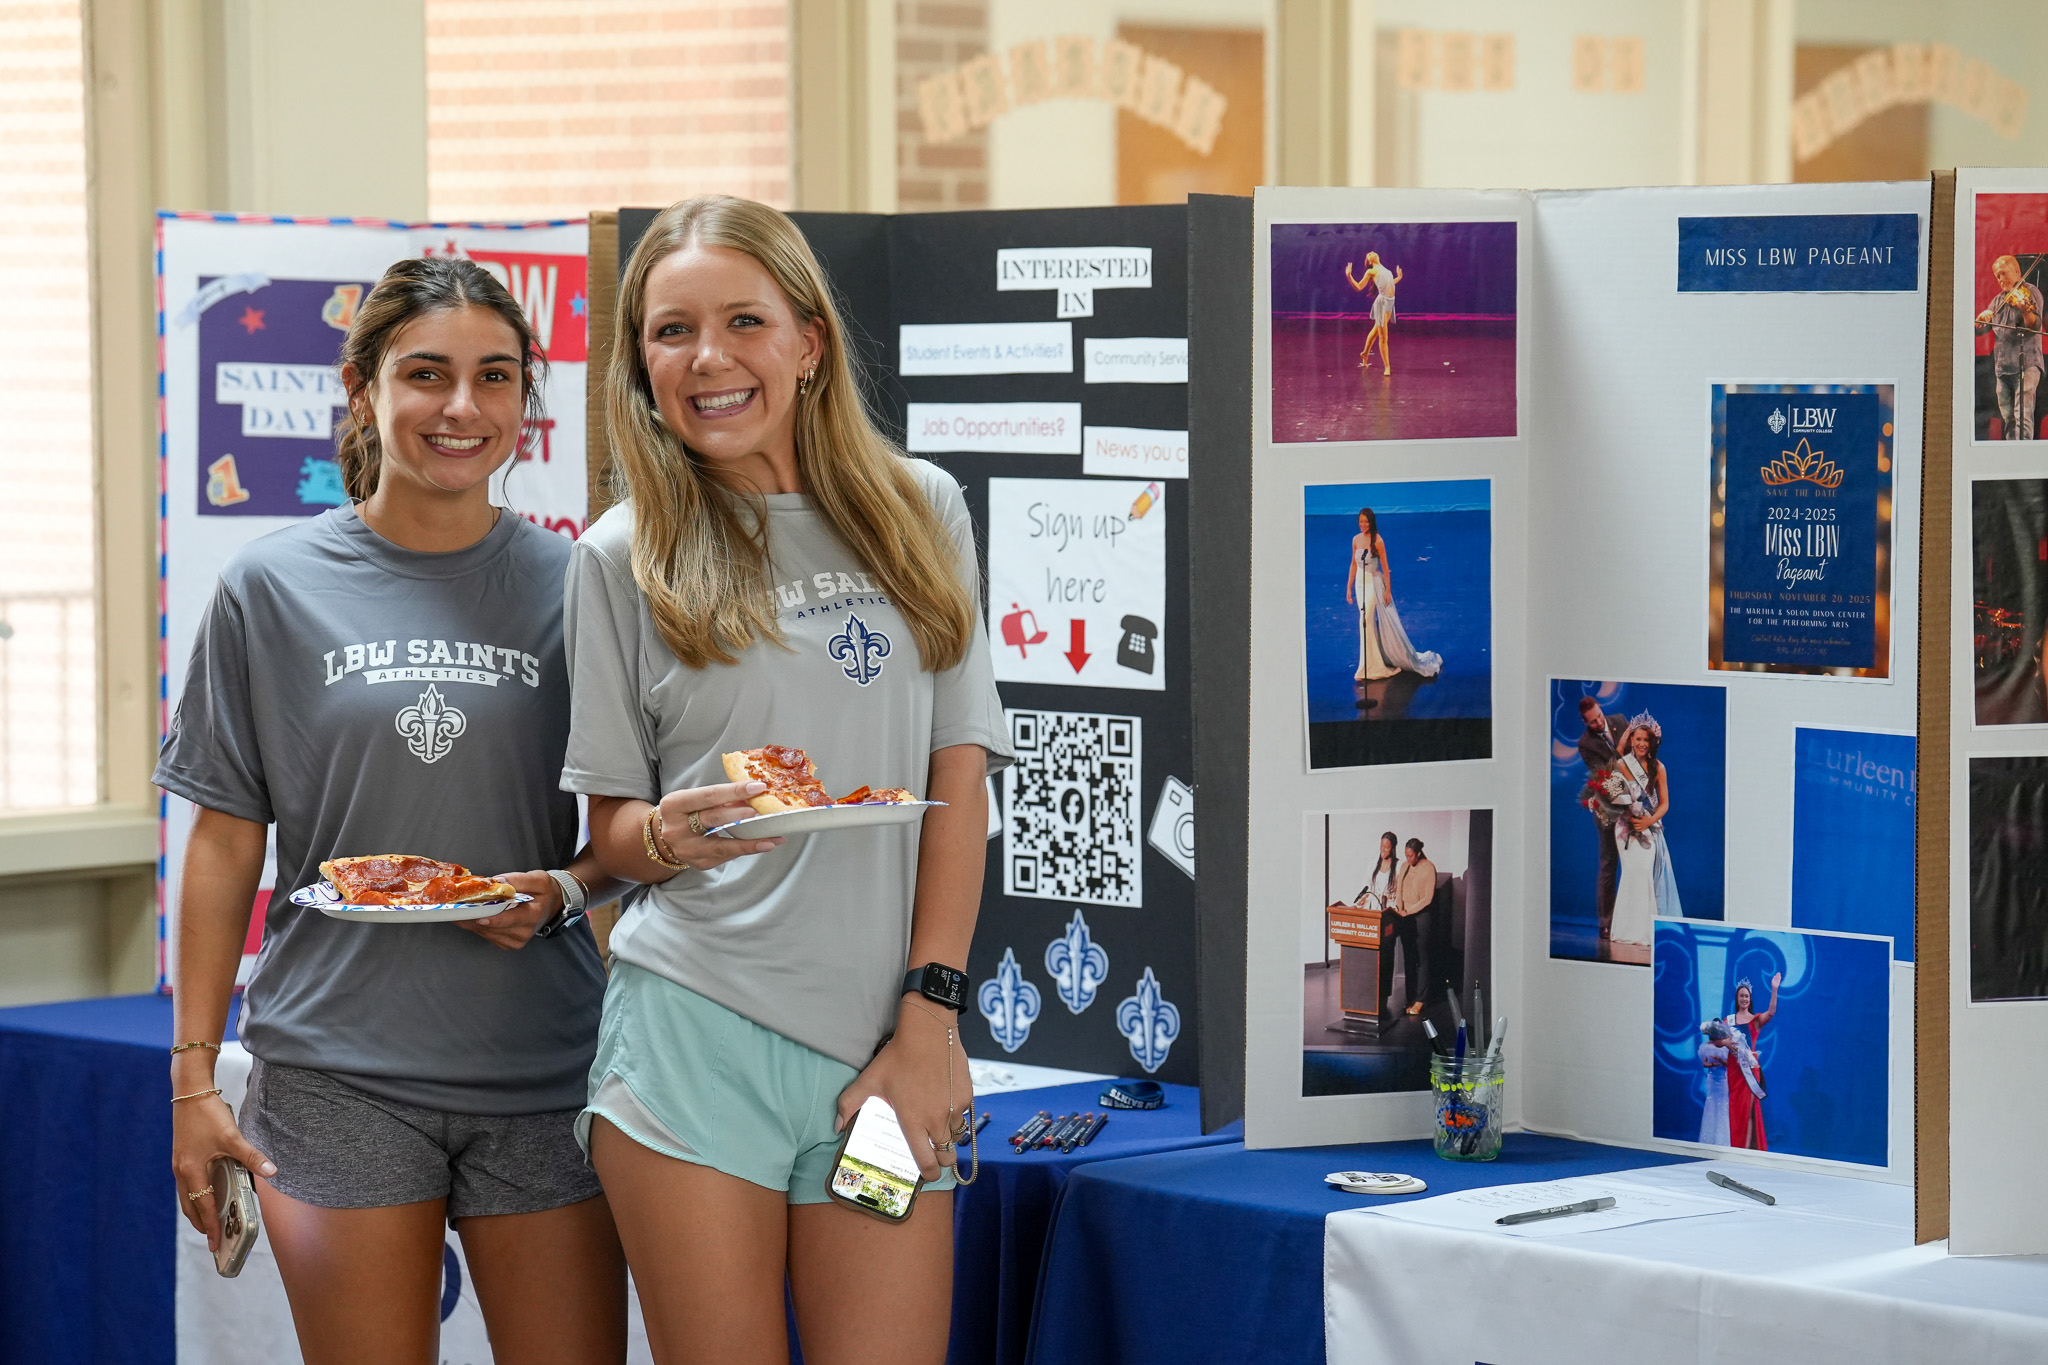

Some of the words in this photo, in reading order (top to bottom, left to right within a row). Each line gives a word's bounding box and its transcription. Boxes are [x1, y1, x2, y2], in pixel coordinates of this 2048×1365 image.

[1705, 248, 1748, 266] MISS
[1757, 247, 1798, 266] LBW
[1808, 246, 1895, 266] PAGEANT
[1001, 256, 1149, 281] INTERESTED
[1063, 292, 1087, 314] IN
[906, 344, 951, 361] Student
[953, 343, 991, 361] Events
[994, 344, 1003, 361] &
[1005, 342, 1065, 360] Activities?
[1094, 350, 1157, 367] Community
[249, 407, 324, 431] DAY
[921, 418, 949, 437] Job
[952, 416, 1066, 440] Opportunities?
[1793, 408, 1837, 428] LBW
[1096, 439, 1138, 460] News
[1142, 445, 1172, 464] you
[1766, 488, 1789, 497] SAVE
[1795, 488, 1809, 497] THE
[1815, 489, 1837, 498] DATE
[1767, 507, 1836, 522] 2024-2025
[1026, 501, 1083, 553] Sign
[1093, 515, 1126, 548] up
[1806, 524, 1840, 558] LBW
[1046, 566, 1108, 603] here
[1776, 558, 1826, 589] Pageant
[812, 572, 887, 600] SAI
[797, 596, 894, 619] ATHLETIC
[1779, 592, 1827, 602] NOVEMBER
[1848, 594, 1871, 604] 2025
[1746, 607, 1775, 615] MARTHA
[1786, 609, 1810, 617] SOLON
[1812, 610, 1835, 618] DIXON
[1837, 611, 1866, 619] CENTER
[1767, 618, 1779, 626] THE
[1782, 619, 1828, 628] PERFORMING
[1831, 620, 1849, 628] ARTS
[323, 640, 397, 687] LBW
[407, 639, 540, 688] SAINTS
[378, 670, 487, 682] ATHLETICS
